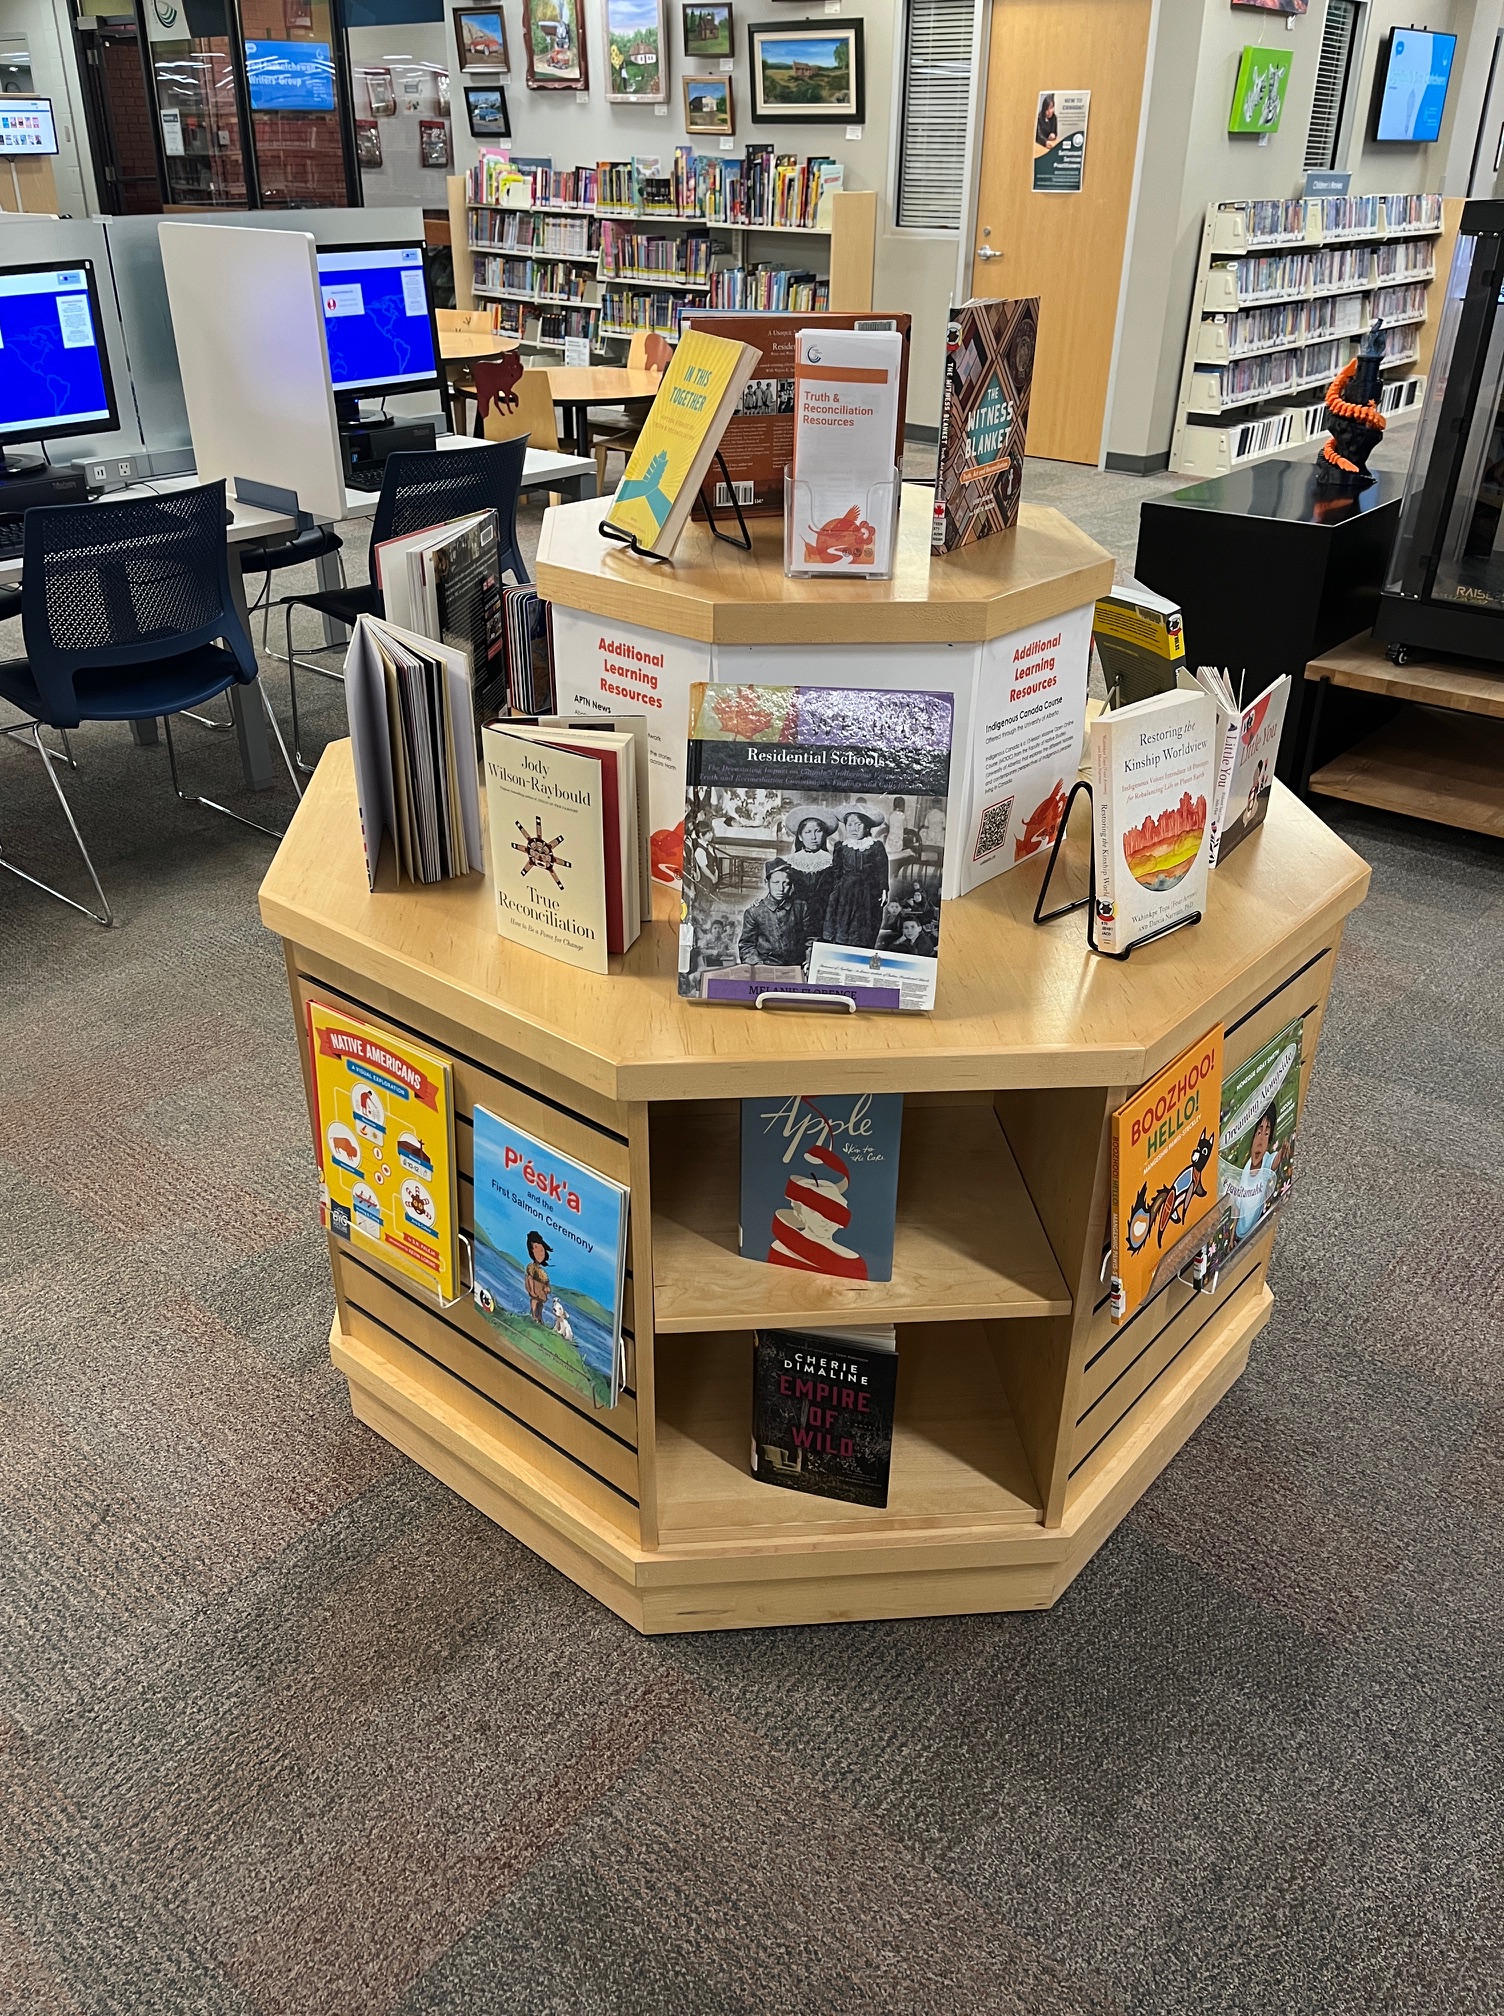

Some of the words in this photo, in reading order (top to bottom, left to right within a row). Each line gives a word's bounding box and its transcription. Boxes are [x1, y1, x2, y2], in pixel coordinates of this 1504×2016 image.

[278, 76, 302, 87] Group
[684, 365, 696, 382] IN
[694, 368, 712, 388] THIS
[670, 386, 706, 412] TOGETHER
[804, 391, 830, 402] Truth
[832, 394, 840, 403] &
[944, 379, 952, 411] WITNESS
[988, 386, 1000, 400] THE
[802, 414, 854, 426] Resources
[803, 403, 874, 416] Reconciliation
[967, 400, 1014, 432] WITNESS
[942, 413, 950, 445] BLANKET
[965, 426, 1012, 459] BLANKET
[598, 638, 664, 668] Additional
[1013, 632, 1062, 664] Additional
[604, 658, 658, 690] Learning
[1014, 657, 1056, 682] Learning
[574, 694, 591, 707] APTN
[592, 700, 612, 714] News
[600, 678, 662, 709] Resources
[1010, 675, 1057, 702] Resources
[985, 714, 1018, 734] Indigenous
[1020, 704, 1044, 720] Canada
[1044, 696, 1063, 710] Course
[985, 734, 1002, 745] Offered
[1002, 728, 1016, 738] through
[1024, 716, 1042, 729] University
[1046, 710, 1060, 720] Alberta
[1140, 726, 1183, 746] Restoring
[1184, 720, 1196, 734] the
[1240, 733, 1262, 768] Little
[1262, 723, 1278, 746] You
[746, 747, 826, 764] Residential
[830, 750, 886, 768] Schools
[986, 750, 1005, 762] Indigenous
[1124, 753, 1160, 773] Kinship
[1162, 740, 1208, 760] Worldview
[1222, 735, 1237, 766] Little
[521, 756, 550, 779] Jody
[1121, 780, 1149, 792] Indigenous
[1150, 775, 1164, 784] Voices
[1164, 768, 1187, 779] Introduce
[1218, 766, 1232, 788] You
[488, 762, 592, 806] Wilson-Raybould
[1126, 796, 1134, 804] for
[1134, 786, 1164, 800] Rebalancing
[1164, 782, 1174, 791] Life
[1180, 776, 1193, 786] Planet
[1193, 772, 1205, 780] Earth
[1100, 804, 1108, 838] Restoring
[1101, 848, 1109, 876] Kinship
[526, 885, 560, 912] True
[498, 890, 596, 940] Reconciliation
[510, 917, 522, 928] How
[528, 924, 535, 933] Be
[540, 929, 554, 941] Force
[554, 936, 562, 944] for
[562, 938, 584, 952] Change
[330, 1033, 364, 1056] NATIVE
[366, 1044, 422, 1090] AMERICANS
[356, 1066, 372, 1079] VISUAL
[372, 1075, 405, 1096] EXPLORATION
[1131, 1048, 1215, 1148] BOOZHOO!
[1224, 1100, 1259, 1144] Dreaming
[1261, 1052, 1292, 1099] Alongside
[760, 1094, 874, 1164] Apple
[1147, 1090, 1200, 1160] HELLO!
[842, 1142, 860, 1154] Skin
[862, 1145, 875, 1153] to
[504, 1146, 582, 1214] P'ésk'a
[492, 1178, 510, 1199] First
[512, 1192, 544, 1221] Salmon
[546, 1216, 594, 1254] Ceremony
[527, 1190, 540, 1204] and
[542, 1200, 554, 1212] the
[784, 1360, 868, 1386] DIMALINE
[794, 1353, 858, 1374] CHERIE
[779, 1374, 871, 1414] EMPIRE
[808, 1406, 838, 1428] OF
[792, 1425, 854, 1457] WILD
